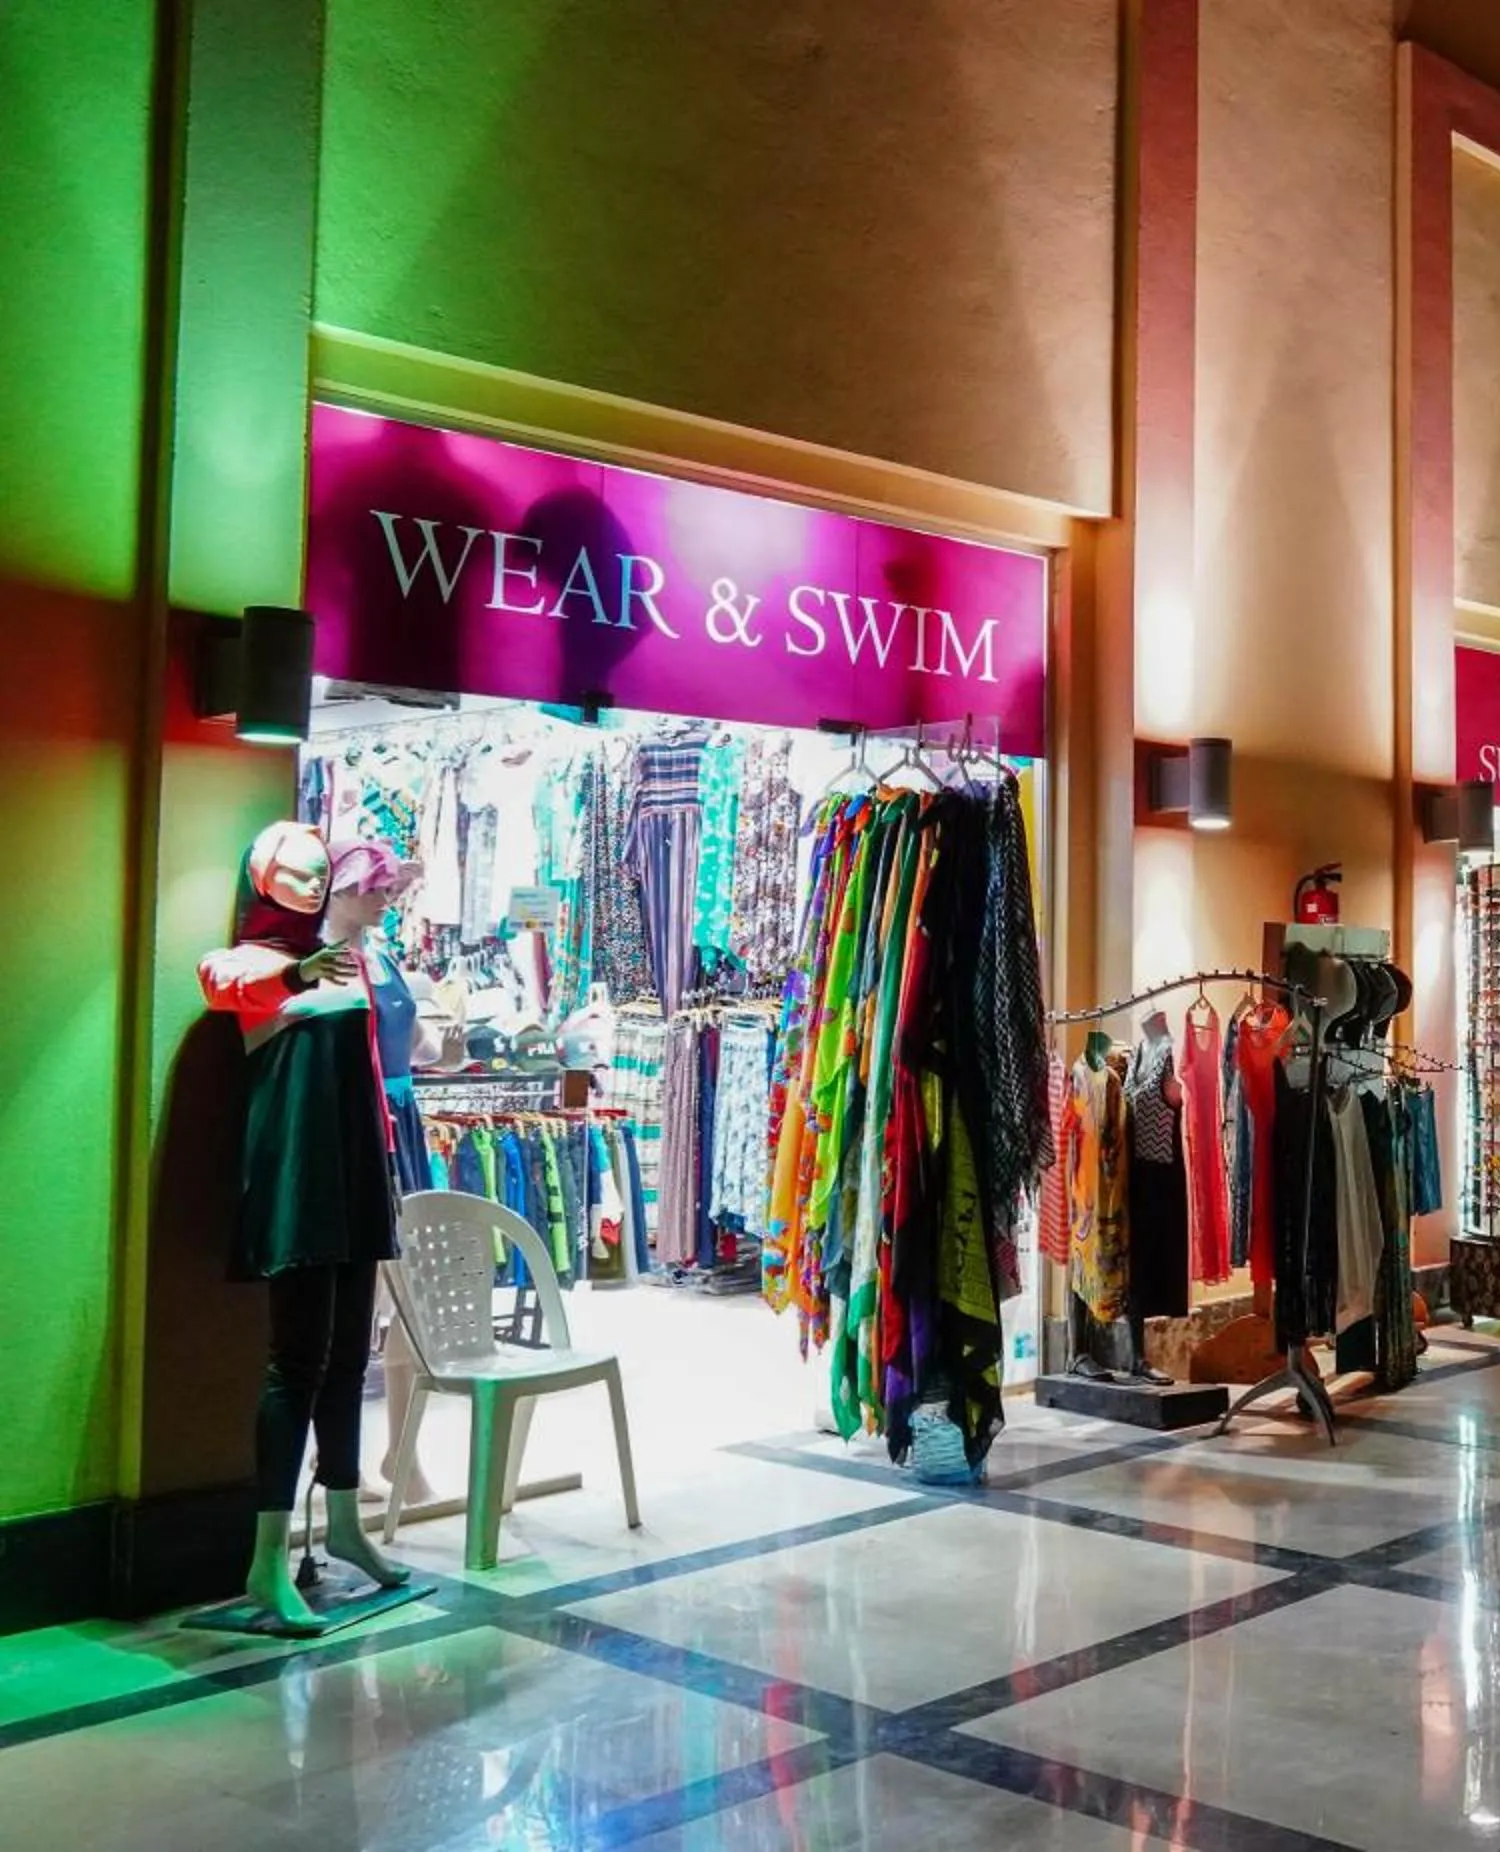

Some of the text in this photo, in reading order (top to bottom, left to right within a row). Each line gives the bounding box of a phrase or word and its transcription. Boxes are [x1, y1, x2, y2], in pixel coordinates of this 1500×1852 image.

[369, 508, 1000, 683] WEAR & SWIM
